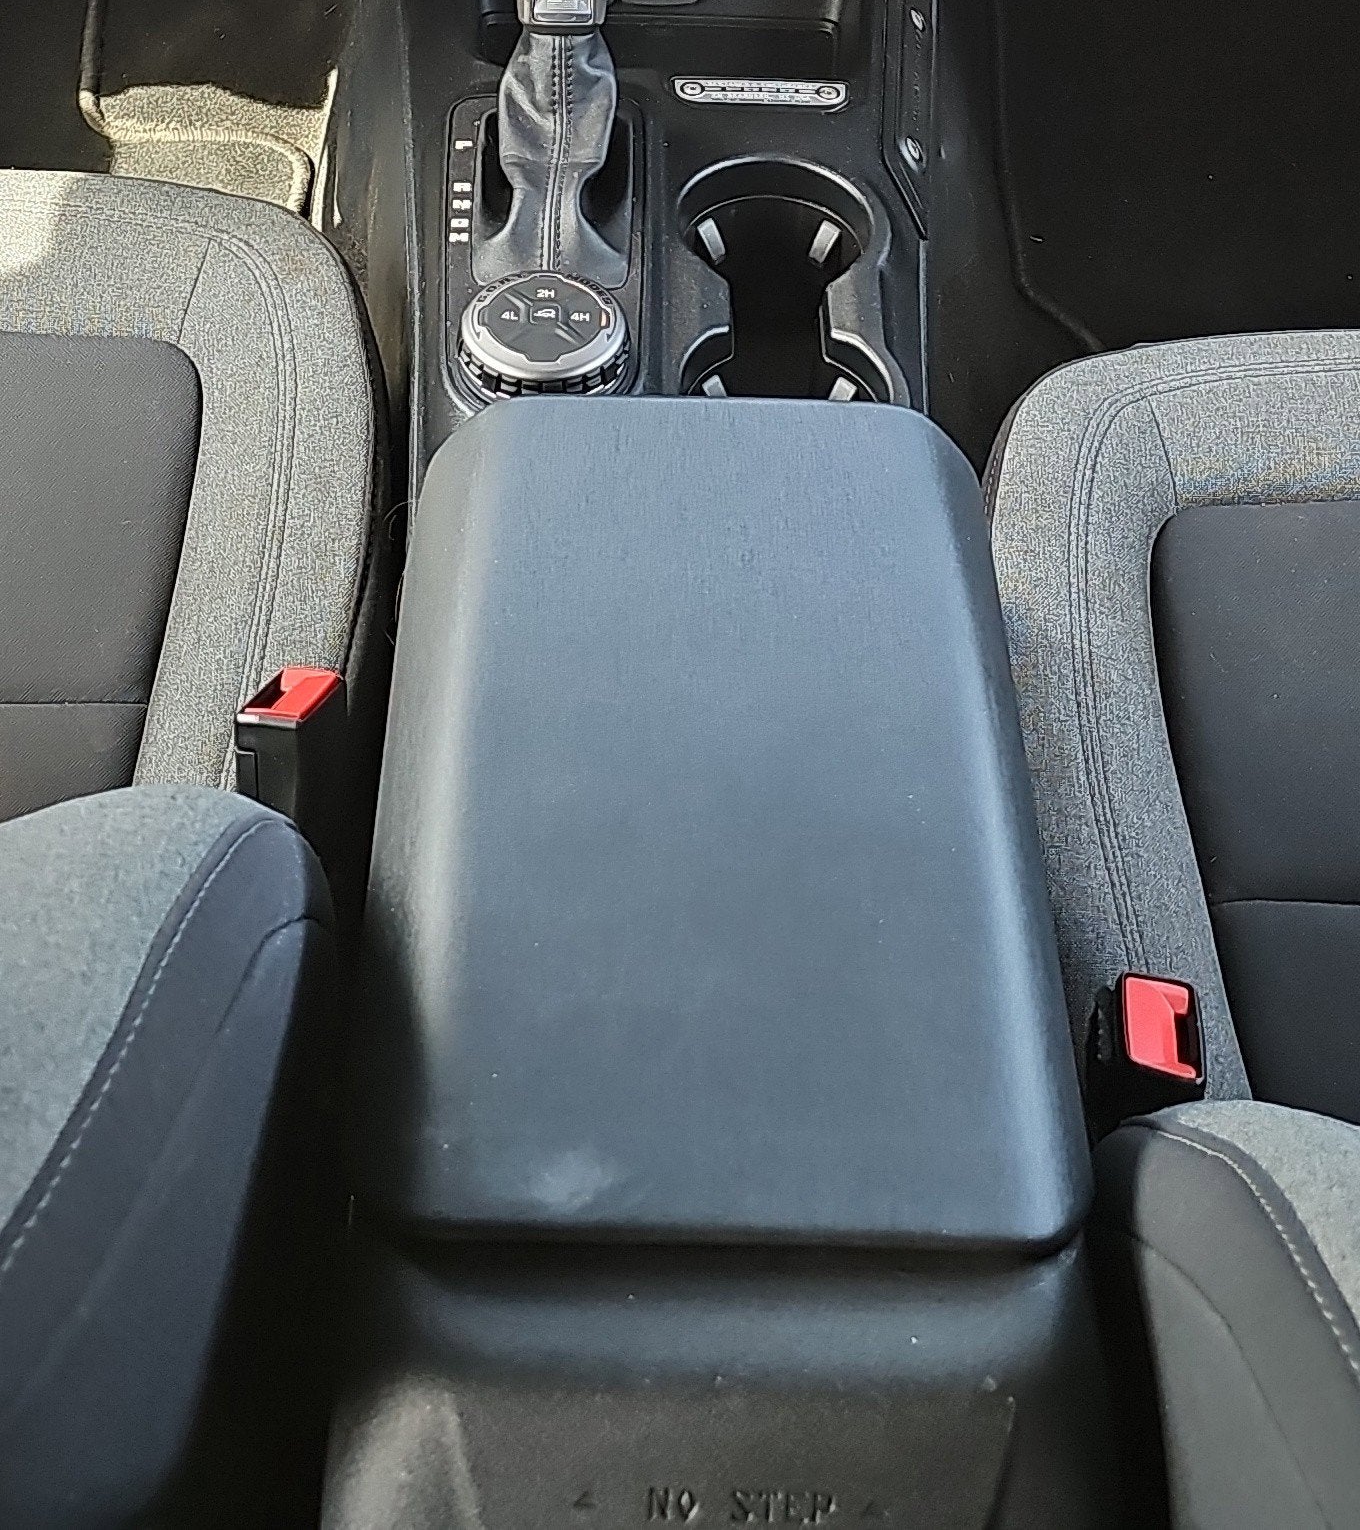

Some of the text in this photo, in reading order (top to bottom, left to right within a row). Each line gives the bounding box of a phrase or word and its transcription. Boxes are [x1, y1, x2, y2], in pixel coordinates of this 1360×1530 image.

[455, 140, 473, 150] P
[452, 199, 472, 210] N
[449, 232, 469, 242] M
[536, 289, 555, 299] 2H
[500, 311, 519, 321] 4L
[570, 312, 590, 322] 4H
[648, 1486, 837, 1524] NO STEP
